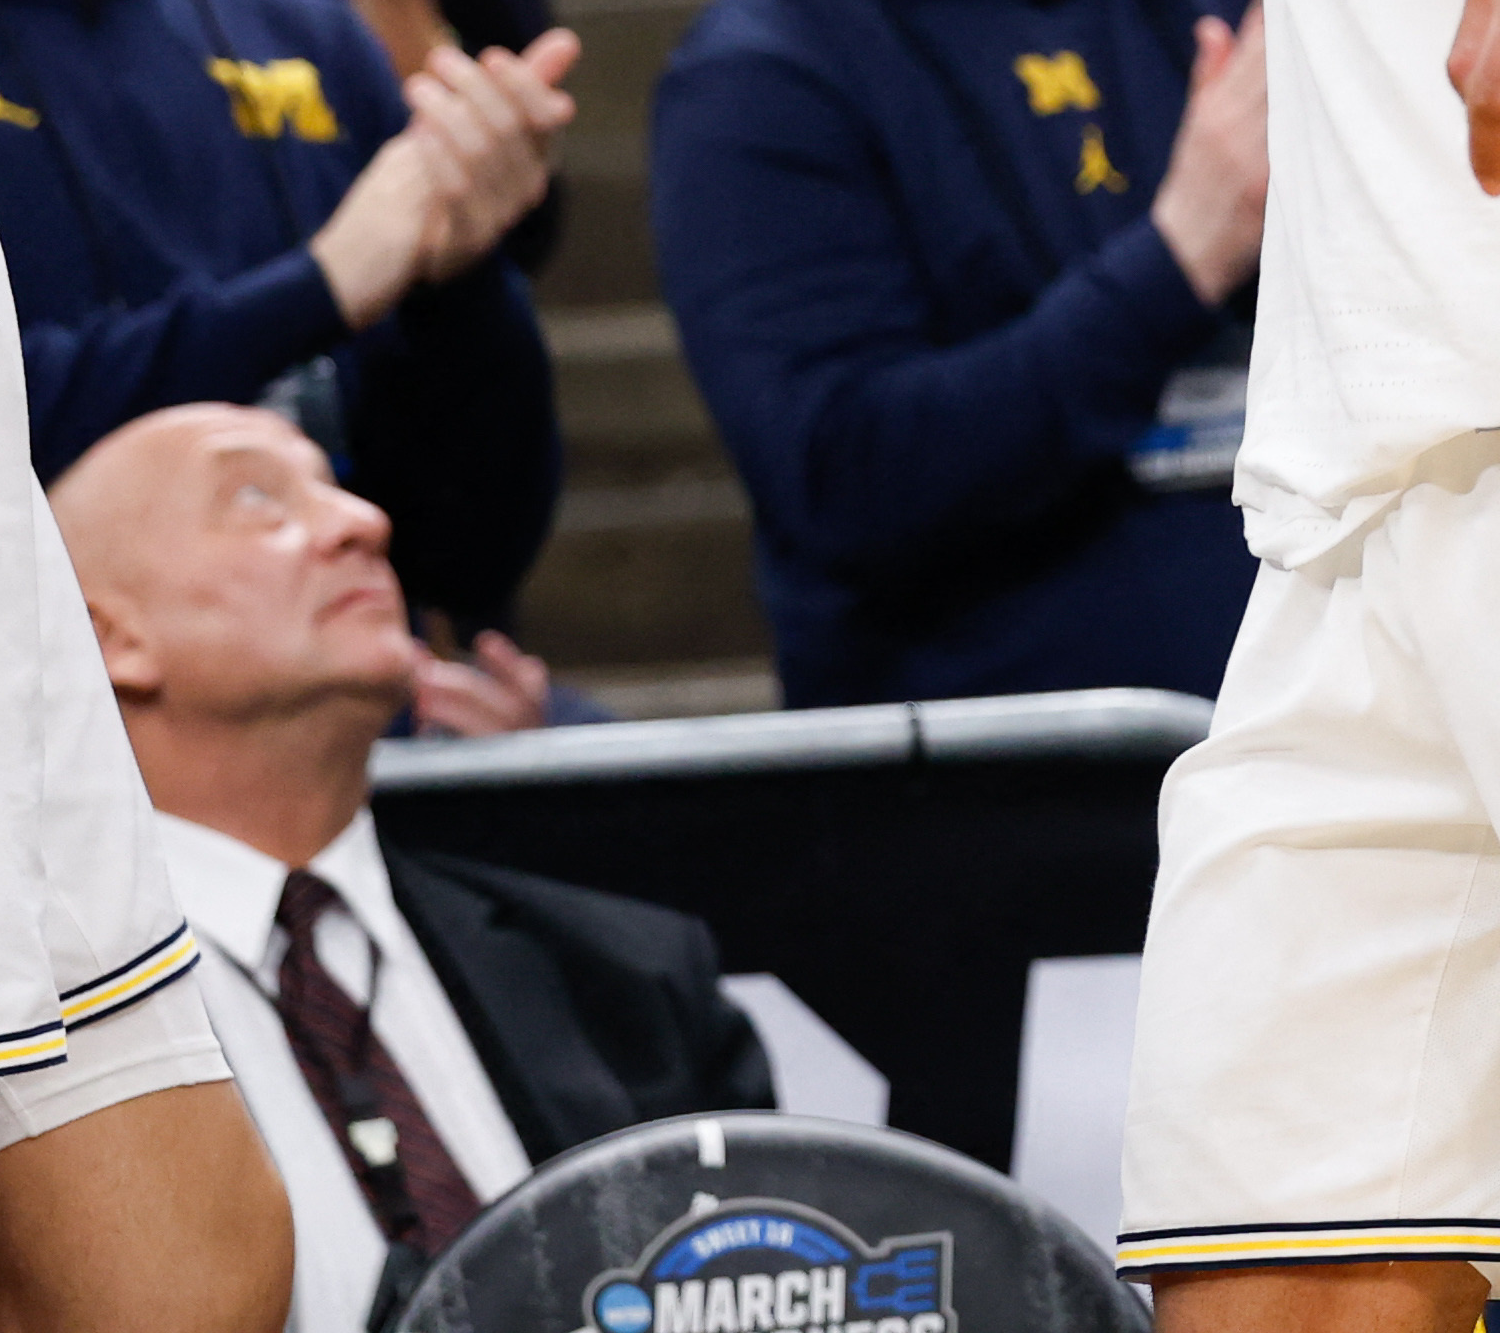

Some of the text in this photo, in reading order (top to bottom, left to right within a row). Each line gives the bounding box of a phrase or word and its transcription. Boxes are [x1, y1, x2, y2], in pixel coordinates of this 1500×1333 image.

[206, 56, 338, 143] M
[1013, 51, 1100, 117] M
[653, 1265, 847, 1333] MARCH
